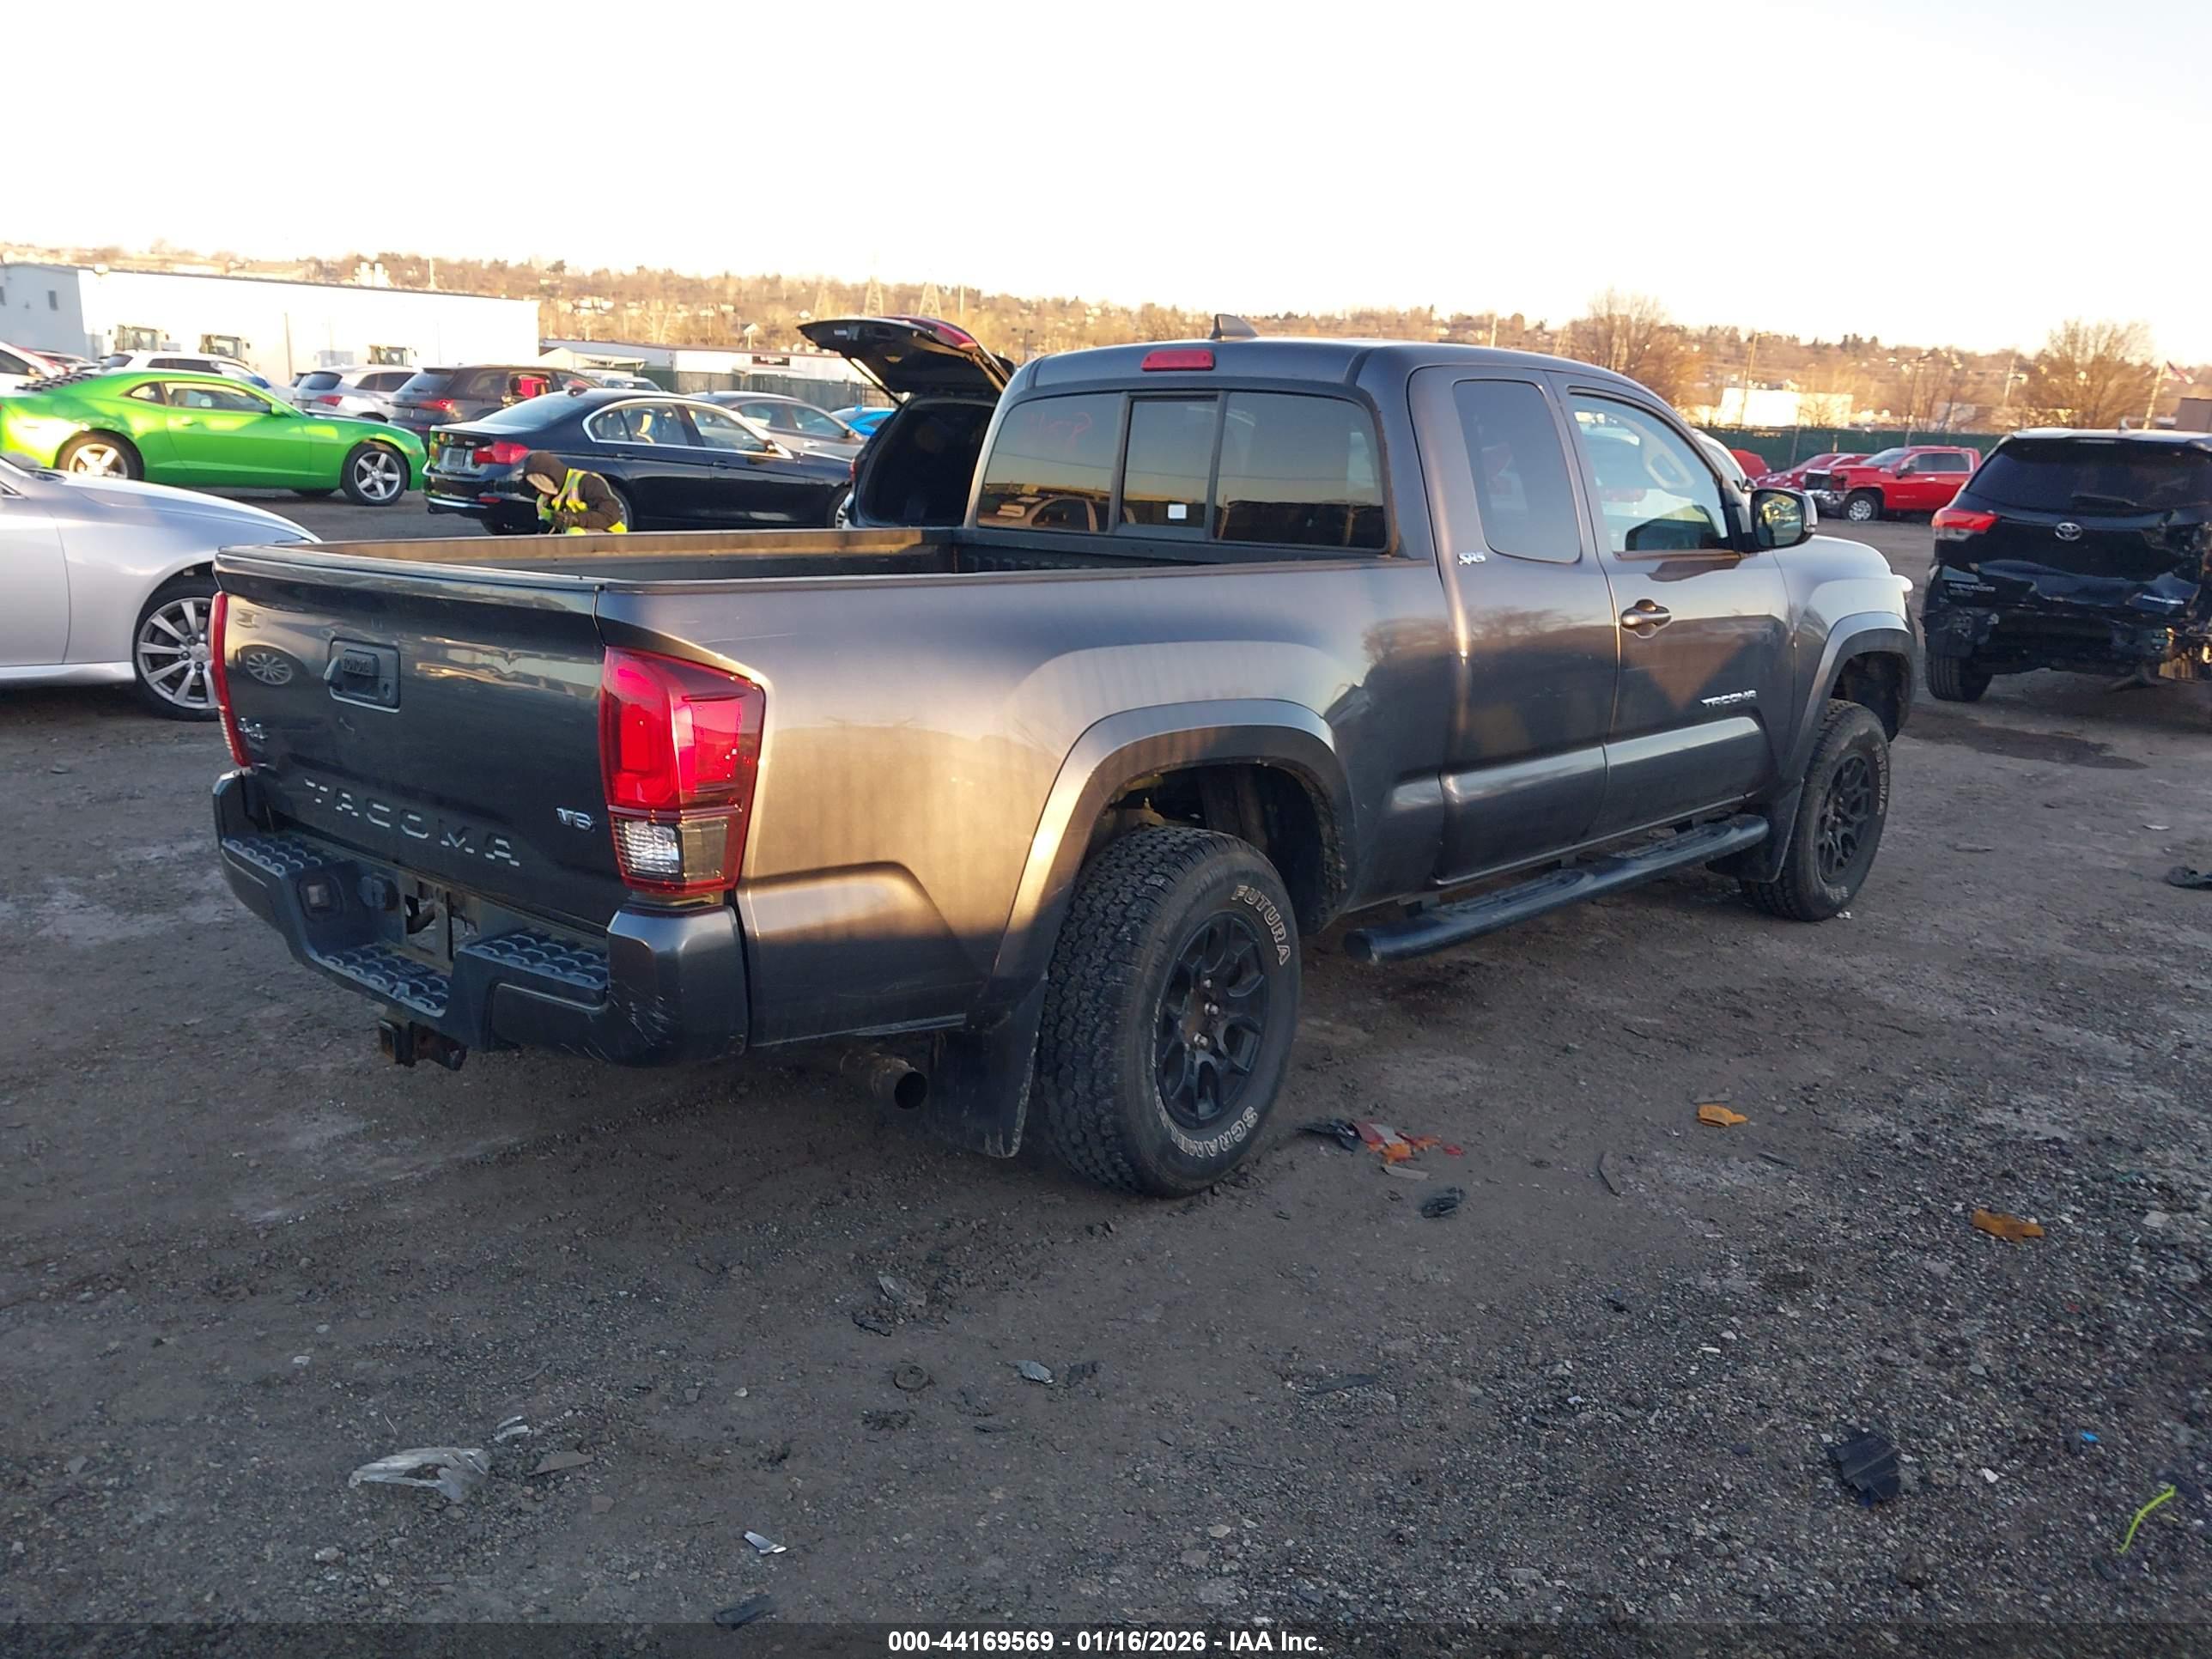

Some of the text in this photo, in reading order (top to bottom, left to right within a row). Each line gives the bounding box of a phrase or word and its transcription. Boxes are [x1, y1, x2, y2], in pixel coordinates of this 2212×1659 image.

[1699, 690, 1758, 707] TACOMA
[304, 778, 521, 867] TACOMA
[556, 807, 592, 831] V6
[1231, 884, 1291, 966] FUTURA
